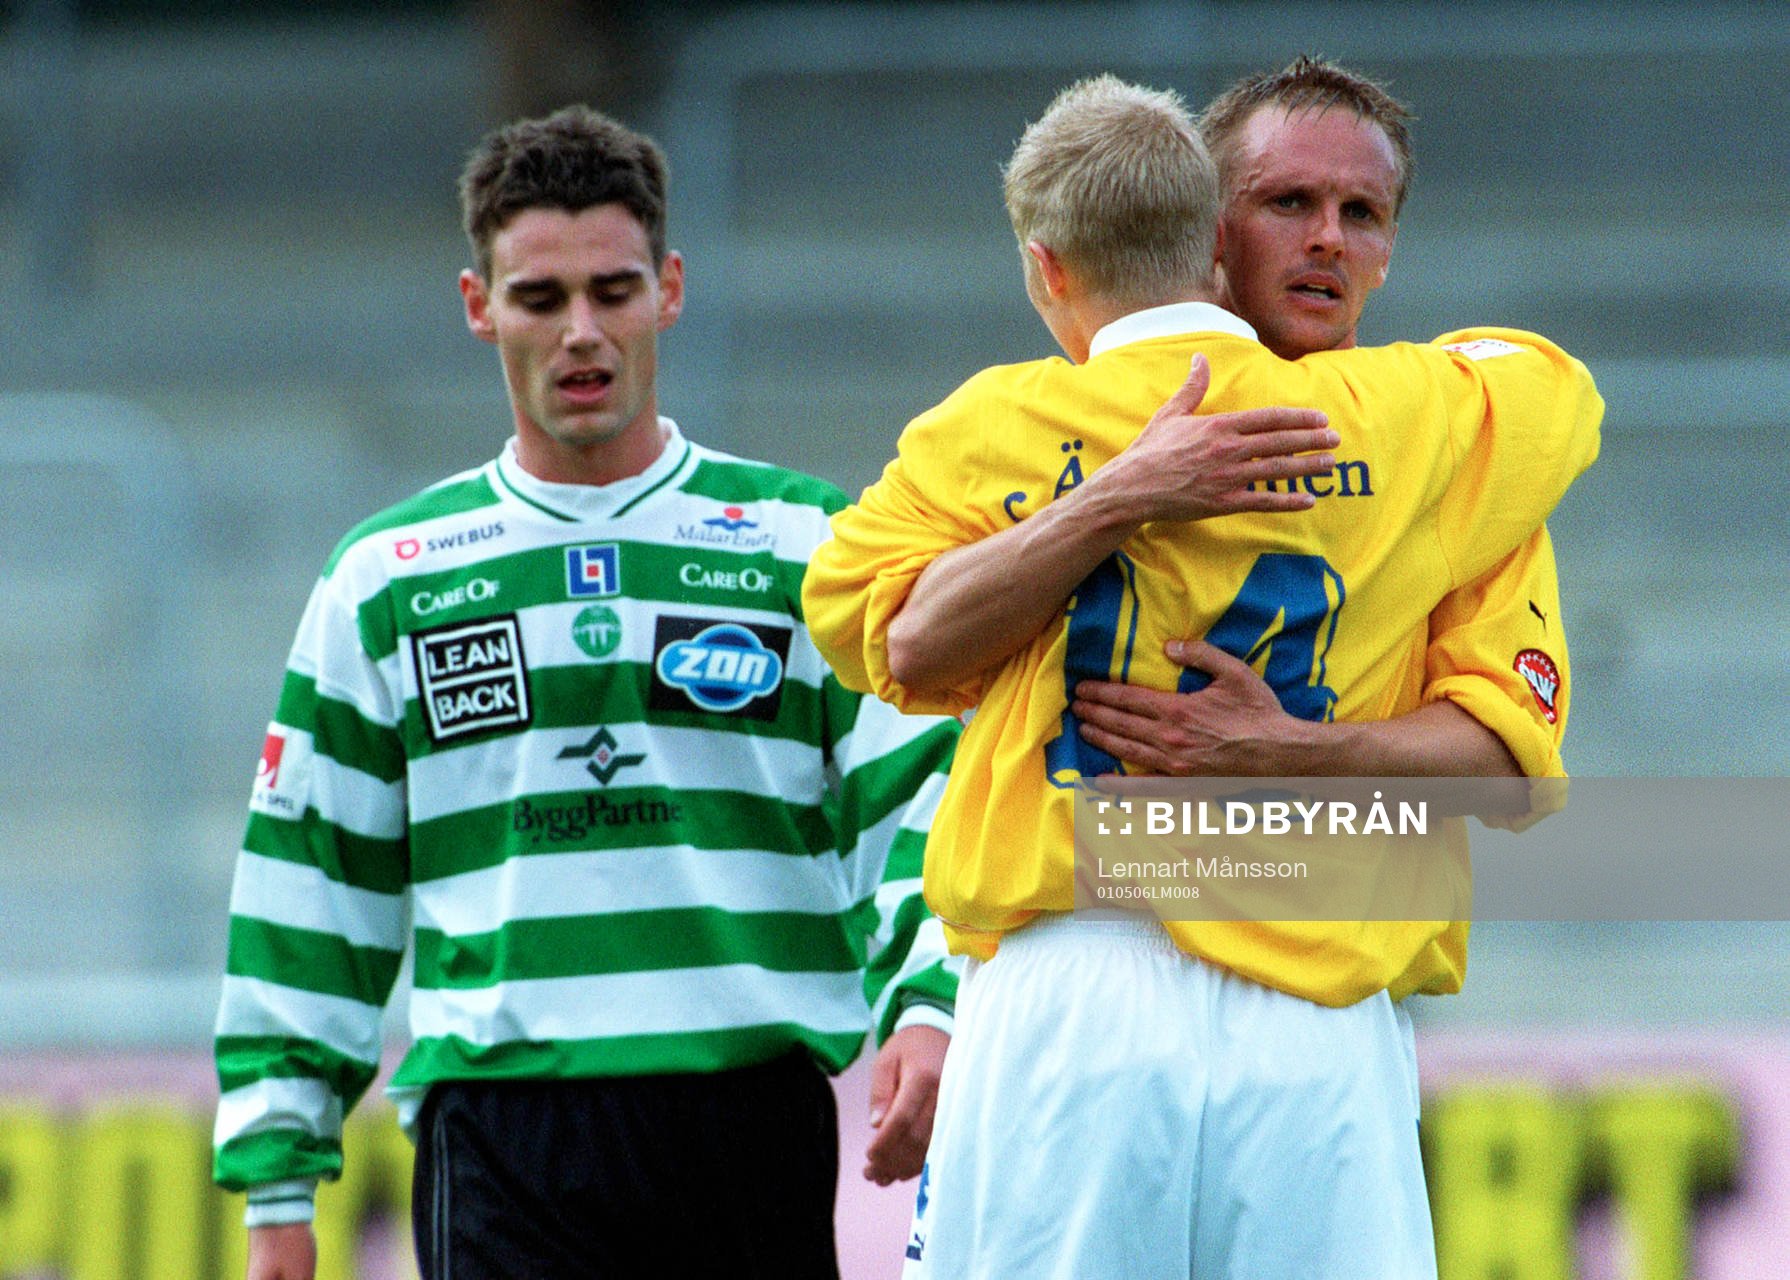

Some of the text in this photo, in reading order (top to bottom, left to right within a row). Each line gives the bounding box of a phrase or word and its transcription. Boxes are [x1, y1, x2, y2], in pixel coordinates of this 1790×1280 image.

[427, 522, 505, 551] SWEBUS
[428, 635, 510, 677] LEAN
[436, 682, 516, 722] BACK
